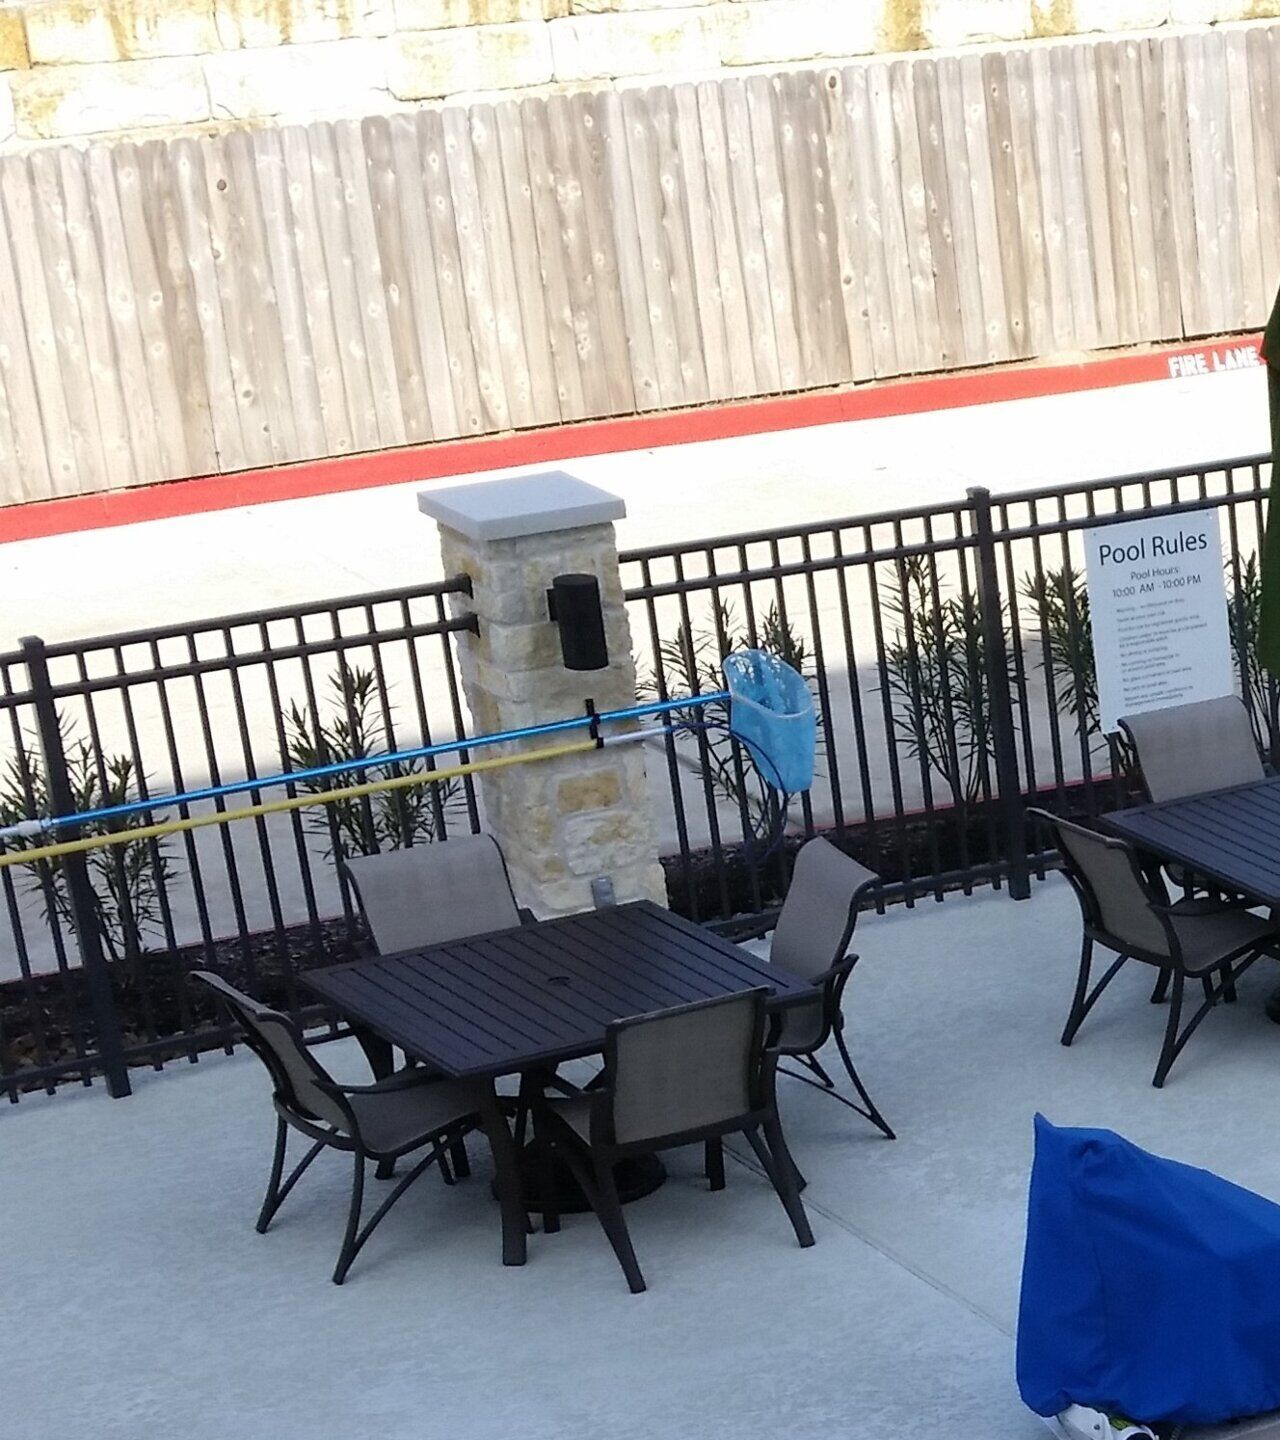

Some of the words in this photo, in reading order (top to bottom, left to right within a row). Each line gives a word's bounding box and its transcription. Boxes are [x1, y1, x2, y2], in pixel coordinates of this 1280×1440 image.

[1167, 352, 1209, 378] FIRE
[1212, 346, 1260, 371] LANE
[1099, 537, 1146, 566] Pool
[1152, 531, 1208, 557] Rules
[1130, 569, 1150, 580] Pool
[1139, 583, 1155, 594] AM
[1186, 574, 1202, 584] PM
